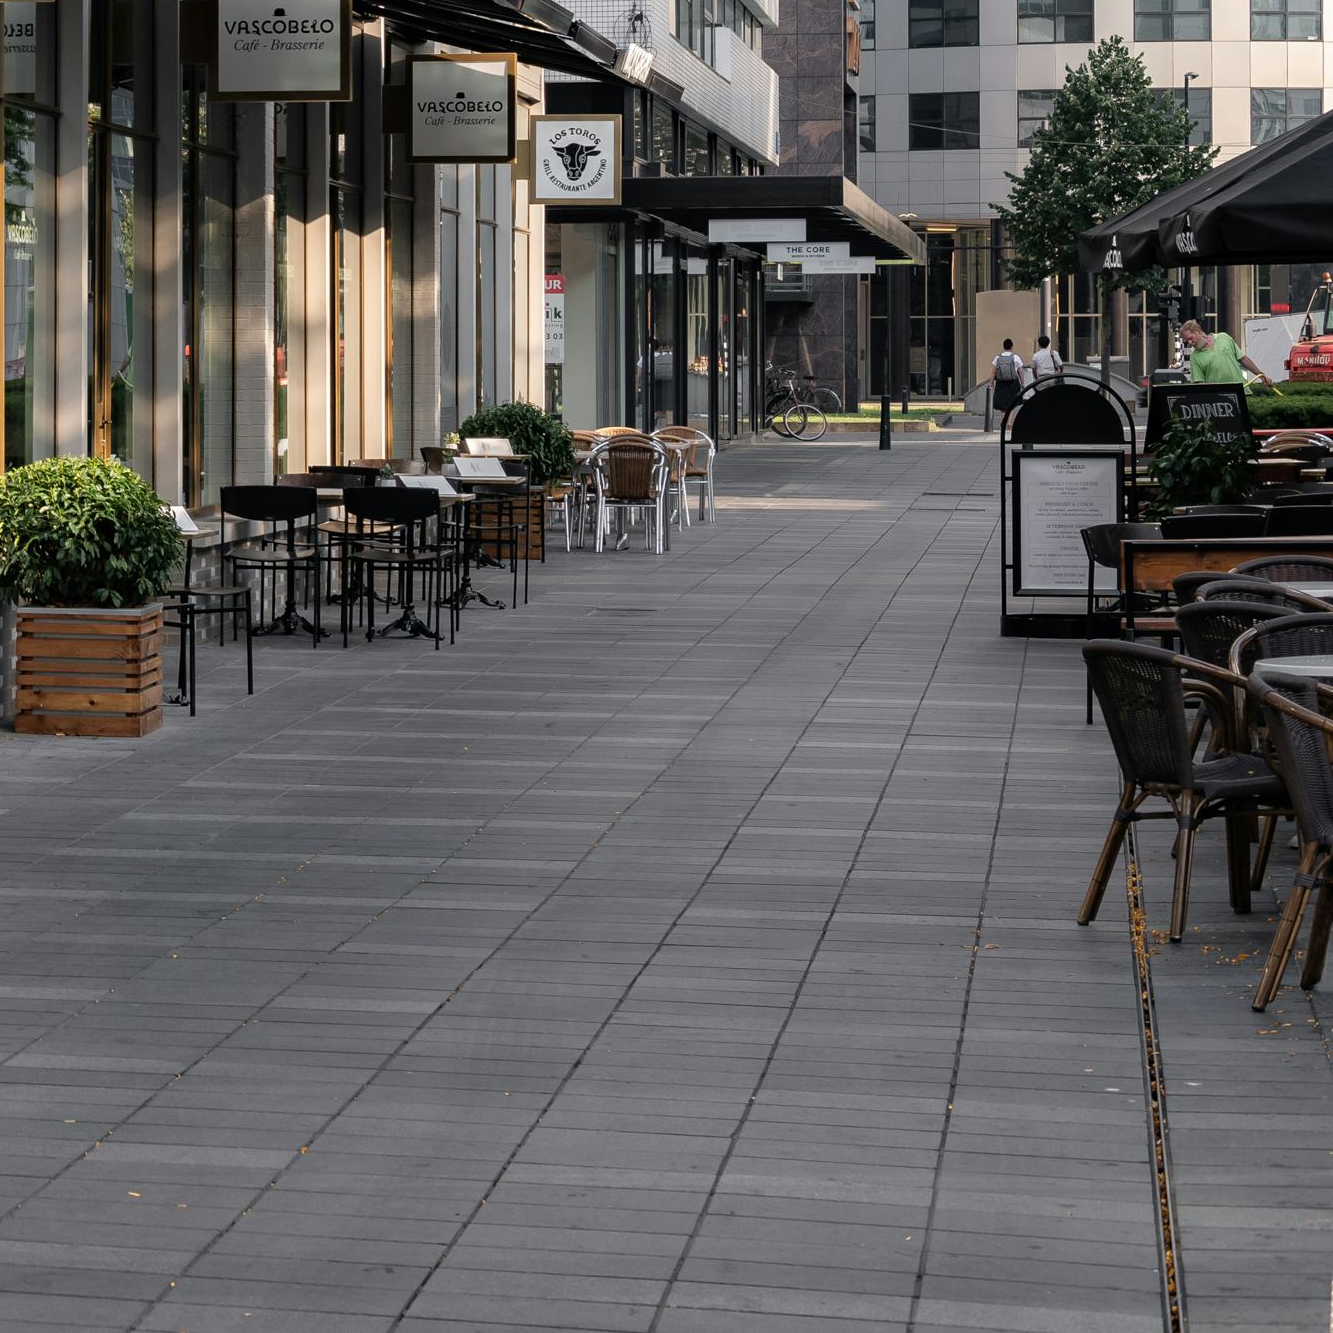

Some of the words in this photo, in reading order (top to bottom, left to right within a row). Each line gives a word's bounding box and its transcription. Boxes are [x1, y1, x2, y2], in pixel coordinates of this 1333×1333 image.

[224, 19, 334, 35] VASCOBELO
[234, 38, 260, 53] Café
[270, 38, 325, 52] Brasserie
[417, 100, 503, 113] VASCOBELO
[424, 116, 445, 127] Café
[453, 115, 496, 126] Brasserie
[549, 129, 567, 145] LOS
[568, 127, 601, 145] TOROS
[543, 159, 552, 176] GRILL
[549, 175, 586, 192] RESTAURANTE
[587, 158, 607, 188] ARGENTINO
[786, 246, 803, 254] THE
[1180, 402, 1234, 420] DINNER
